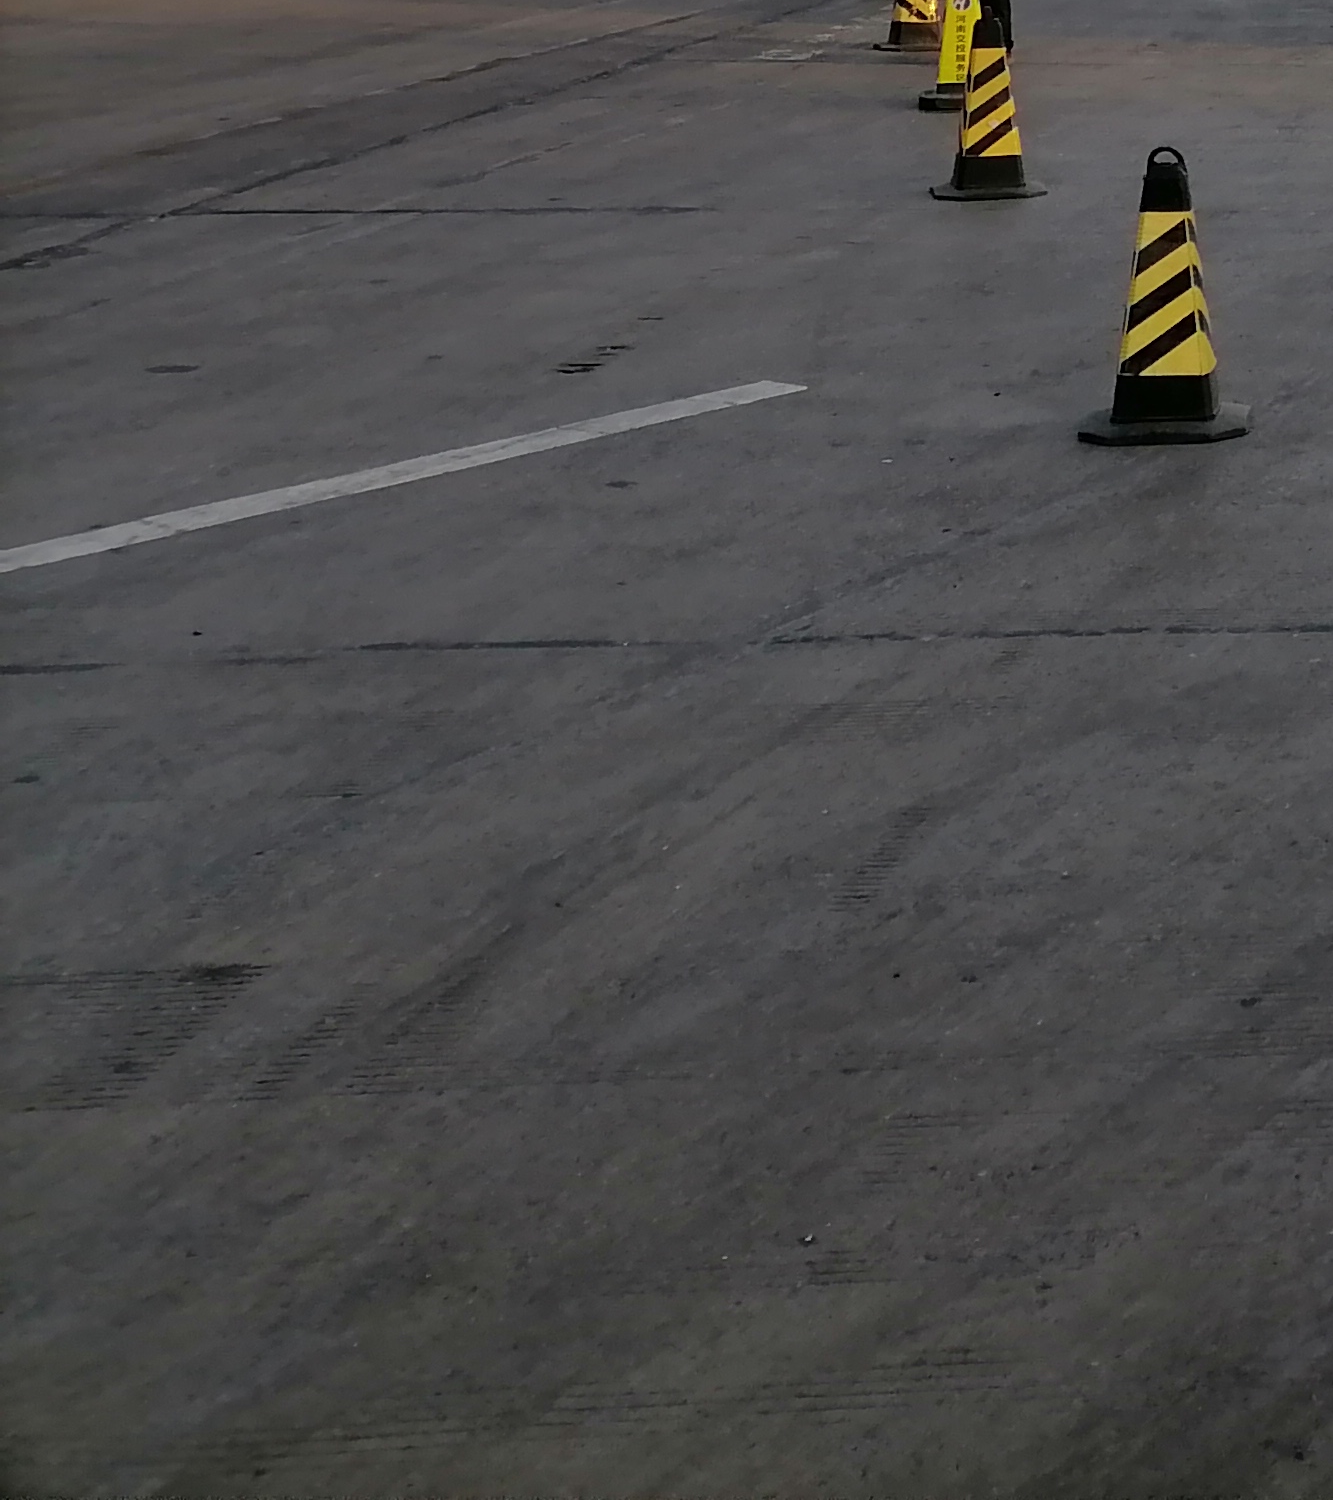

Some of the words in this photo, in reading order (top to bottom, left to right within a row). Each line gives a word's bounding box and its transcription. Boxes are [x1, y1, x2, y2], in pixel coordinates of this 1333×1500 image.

[955, 15, 967, 82] 河南交投服务区
